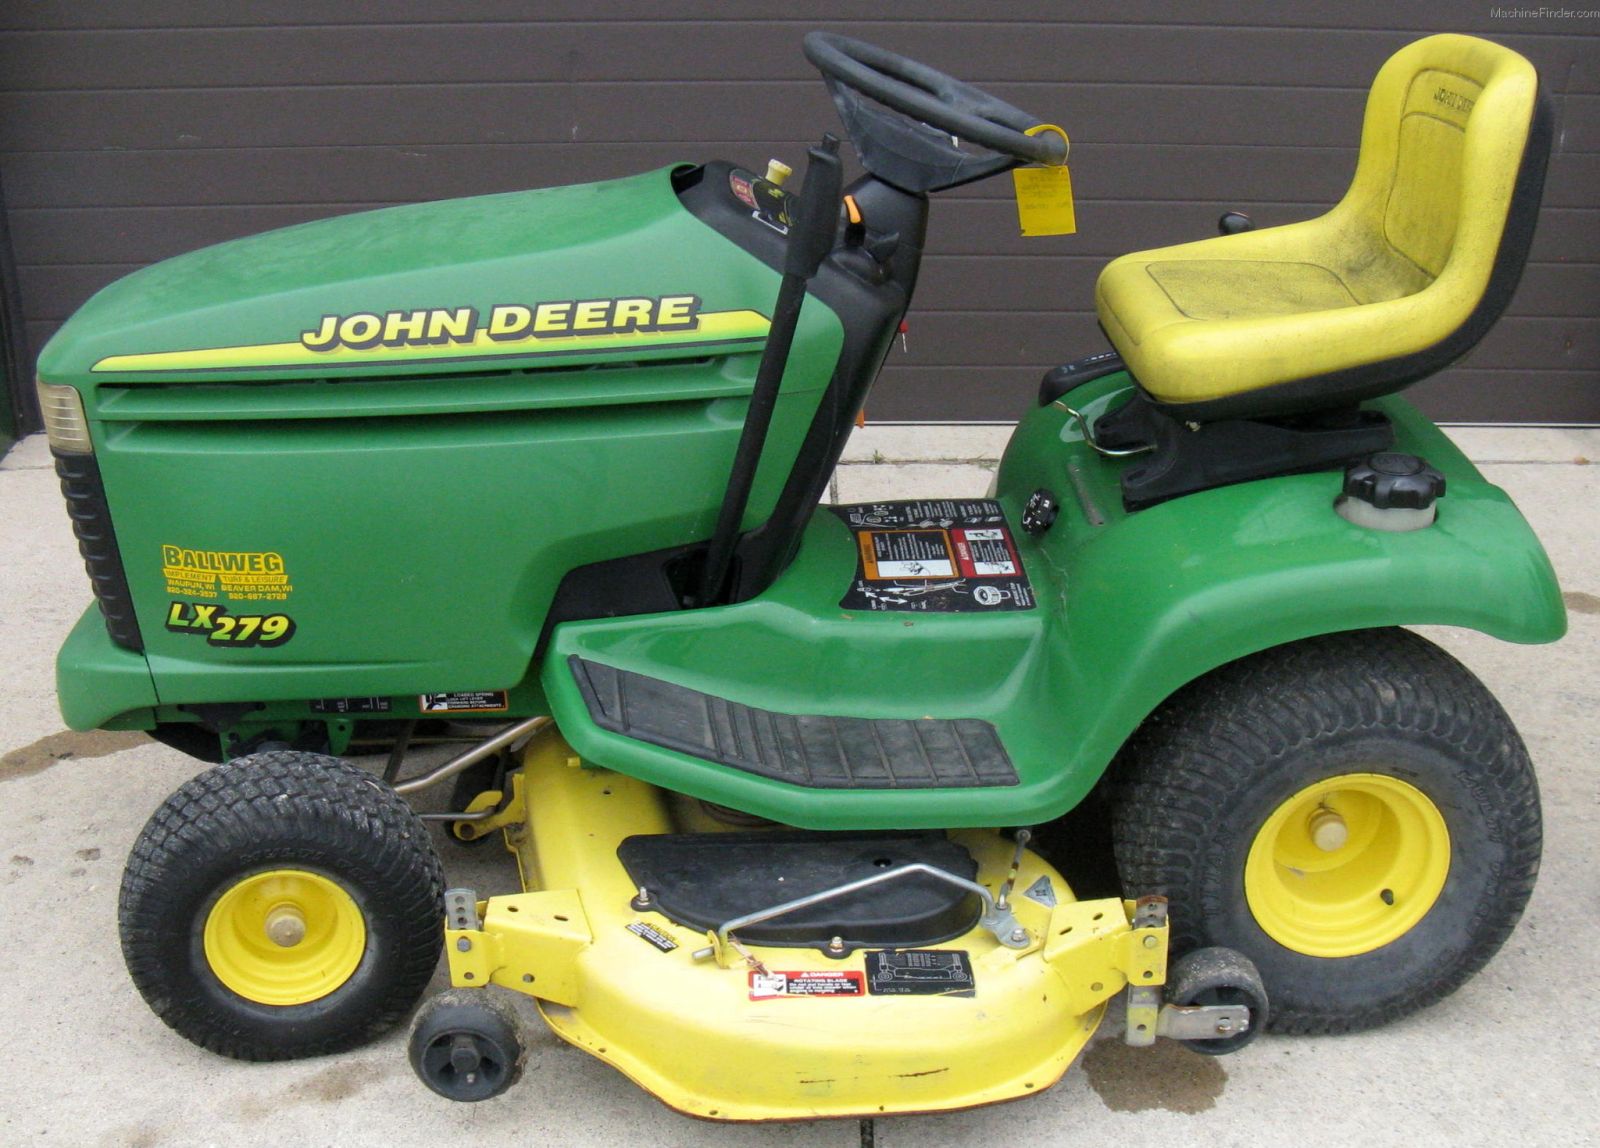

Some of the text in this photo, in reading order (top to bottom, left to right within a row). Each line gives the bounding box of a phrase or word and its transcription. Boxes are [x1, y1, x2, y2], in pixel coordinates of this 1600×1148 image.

[302, 295, 699, 351] JOHN DEERE
[163, 545, 284, 574] BALLWEG
[166, 570, 213, 581] IMPLEMENT
[222, 575, 243, 584] TURF
[252, 575, 286, 584] LEISURE
